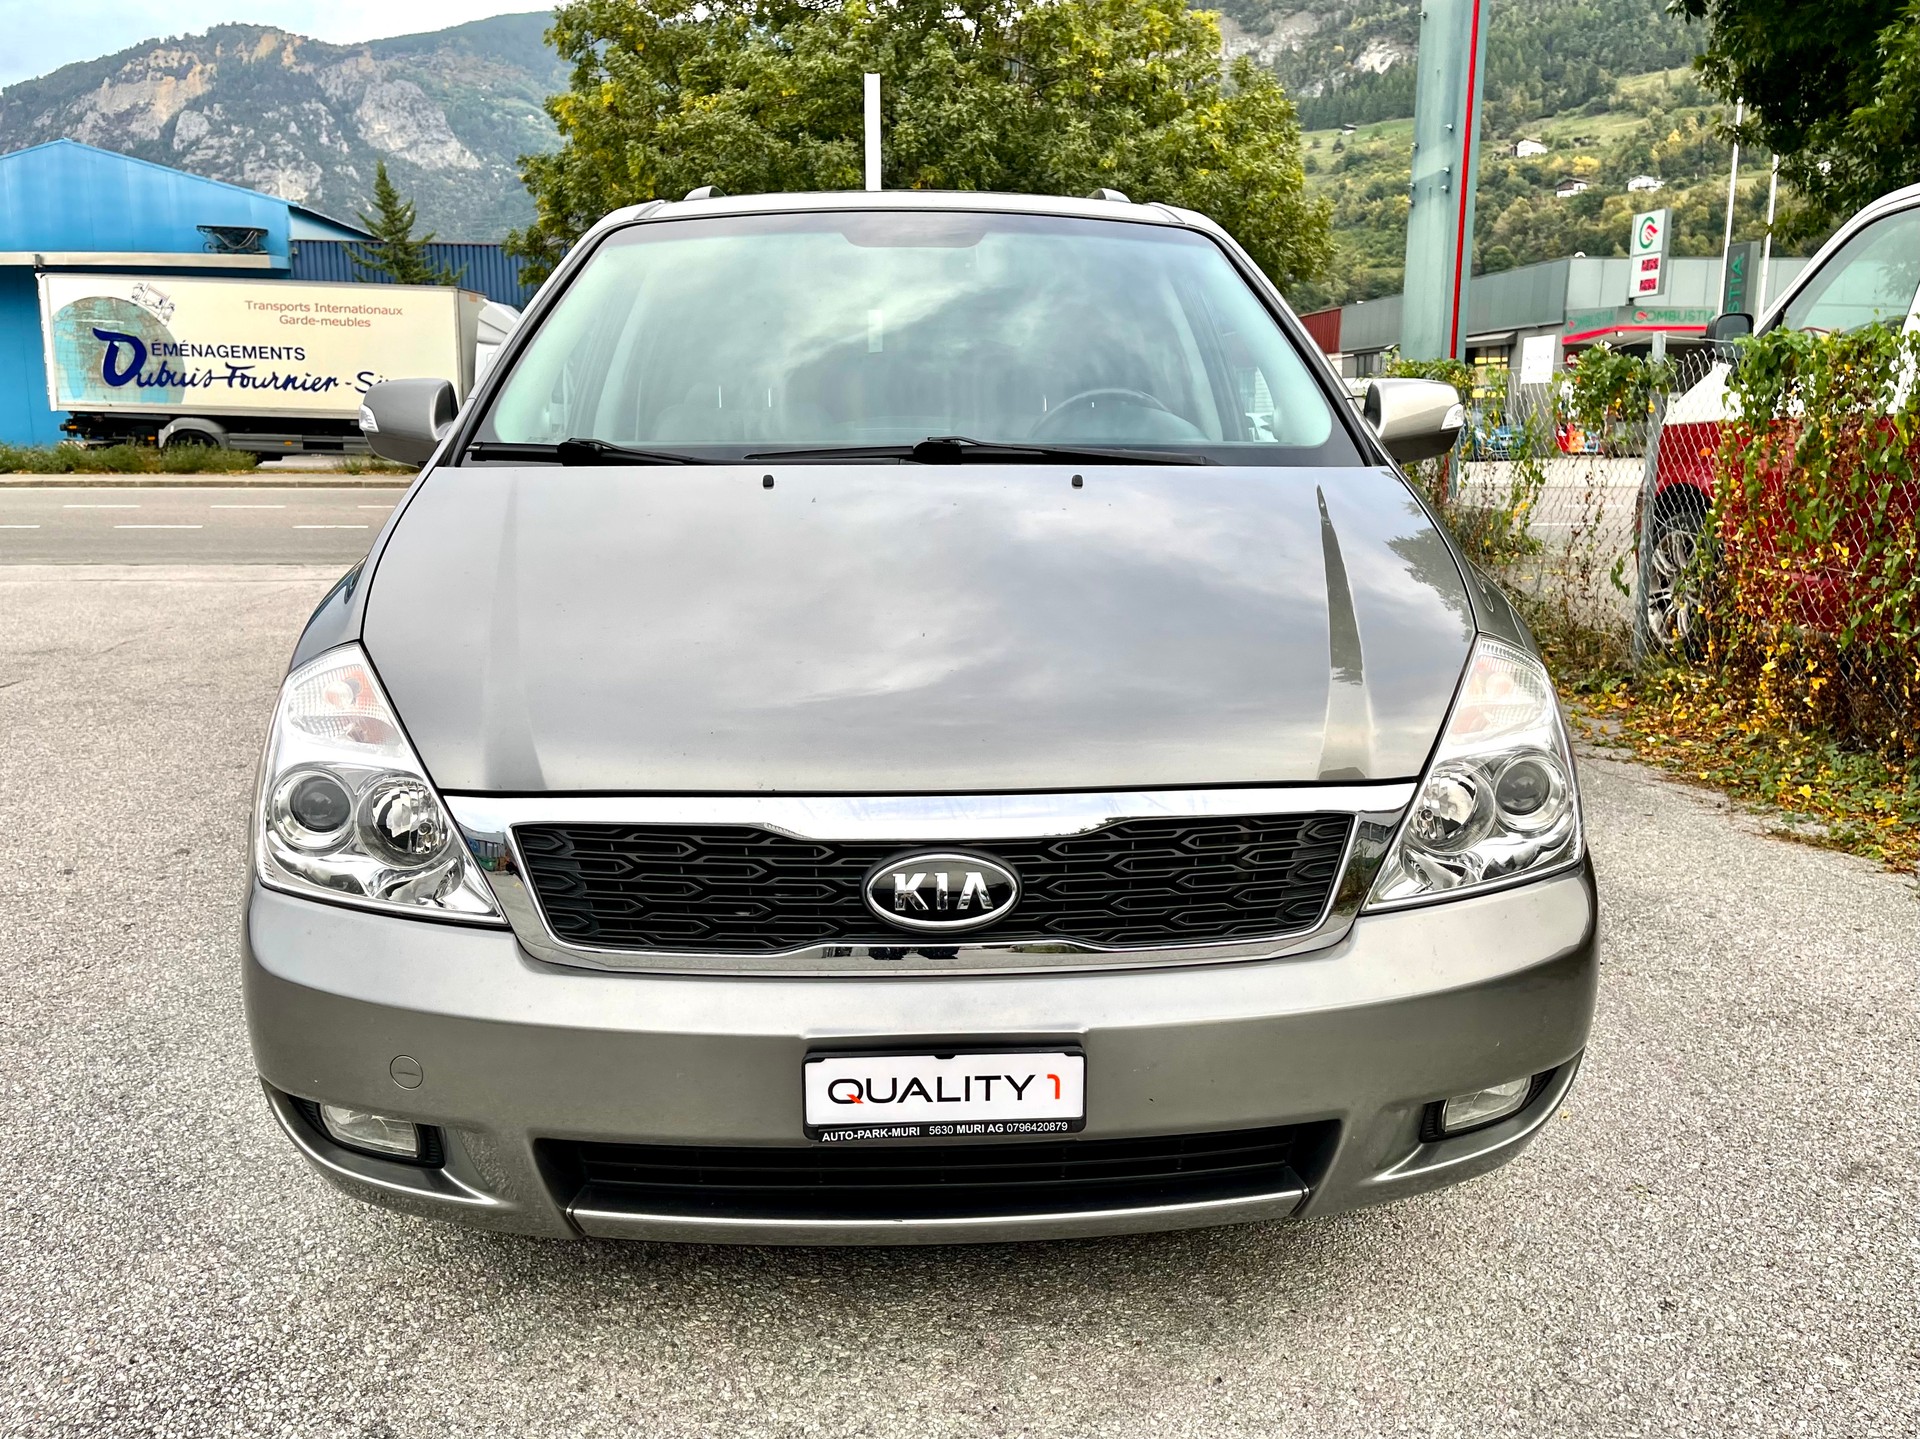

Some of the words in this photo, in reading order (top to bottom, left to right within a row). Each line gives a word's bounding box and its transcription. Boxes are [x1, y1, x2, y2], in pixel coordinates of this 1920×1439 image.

[244, 300, 311, 313] Transports
[314, 302, 404, 316] Internationaux
[278, 314, 372, 328] Garde-meubles
[892, 872, 994, 911] KIA
[827, 1074, 1036, 1105] QUALITY
[1046, 1073, 1061, 1100] 1
[821, 1126, 920, 1142] AUTO-PARK-MURI
[928, 1125, 954, 1136] 5630
[956, 1123, 985, 1134] MURI
[986, 1123, 1004, 1133] AG
[1006, 1121, 1068, 1133] 0796420879
